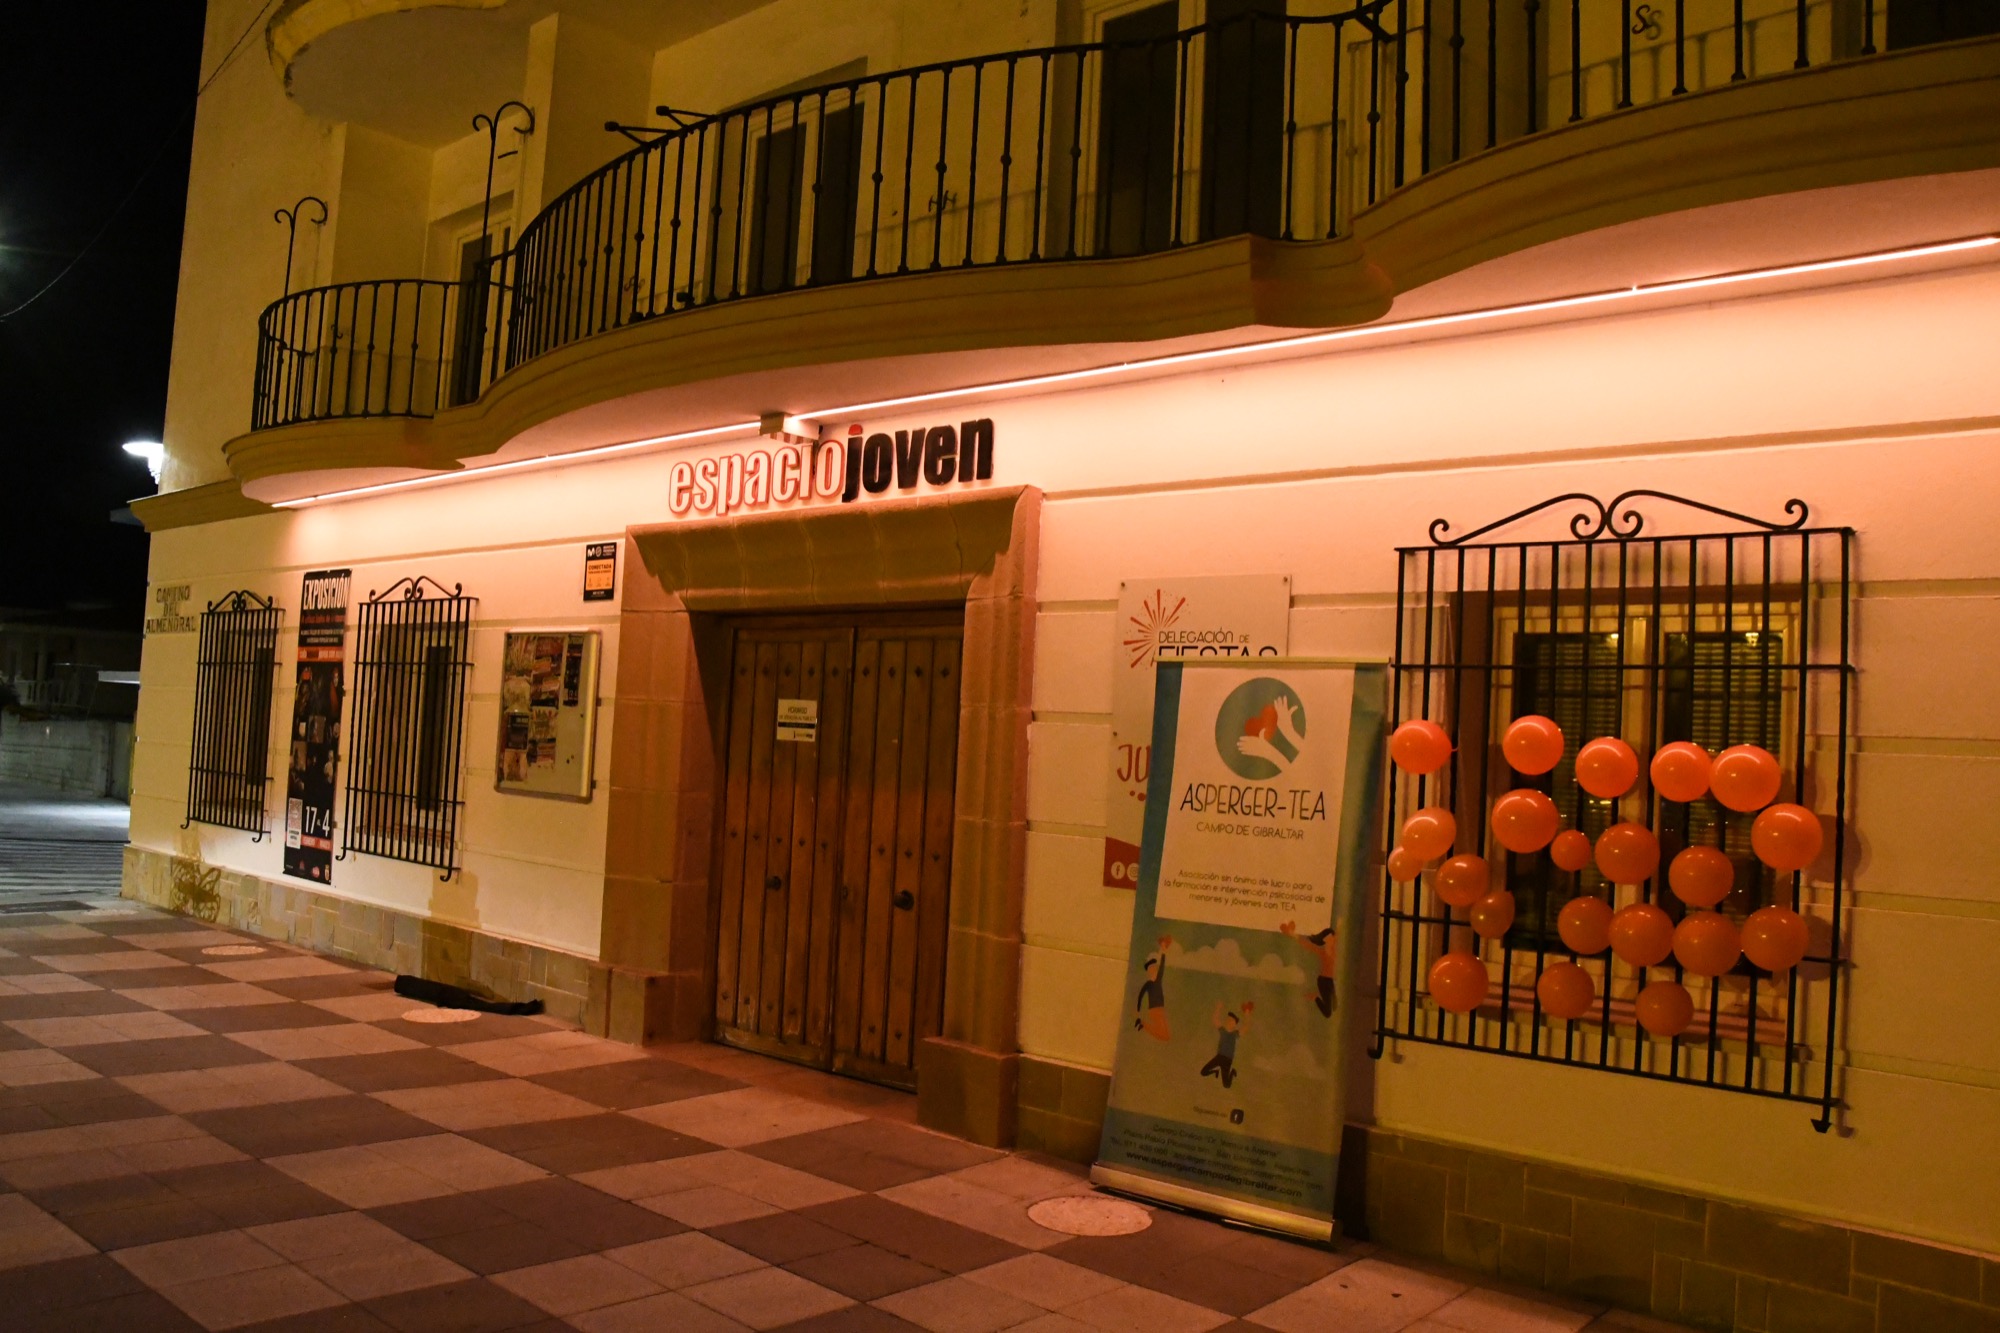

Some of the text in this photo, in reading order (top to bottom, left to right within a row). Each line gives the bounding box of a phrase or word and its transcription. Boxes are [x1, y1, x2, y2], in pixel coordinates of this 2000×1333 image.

[156, 585, 190, 603] CAMINO
[303, 573, 351, 610] EXPOSICIÓN
[163, 601, 179, 617] DEL
[146, 616, 196, 633] ALMENDRAL
[1158, 627, 1250, 644] DELEGACIÓN DE
[1180, 783, 1326, 821] ASPERGER-TEA
[306, 806, 318, 834] 17
[322, 809, 330, 837] 4
[1196, 822, 1305, 840] CAMPO DE GIBRALTAR
[1178, 869, 1313, 893] Asociación sin ánimo de lucro para
[1163, 879, 1326, 904] la formación e intervención psicosocial de
[1188, 893, 1297, 912] menores y jóvenes con TEA
